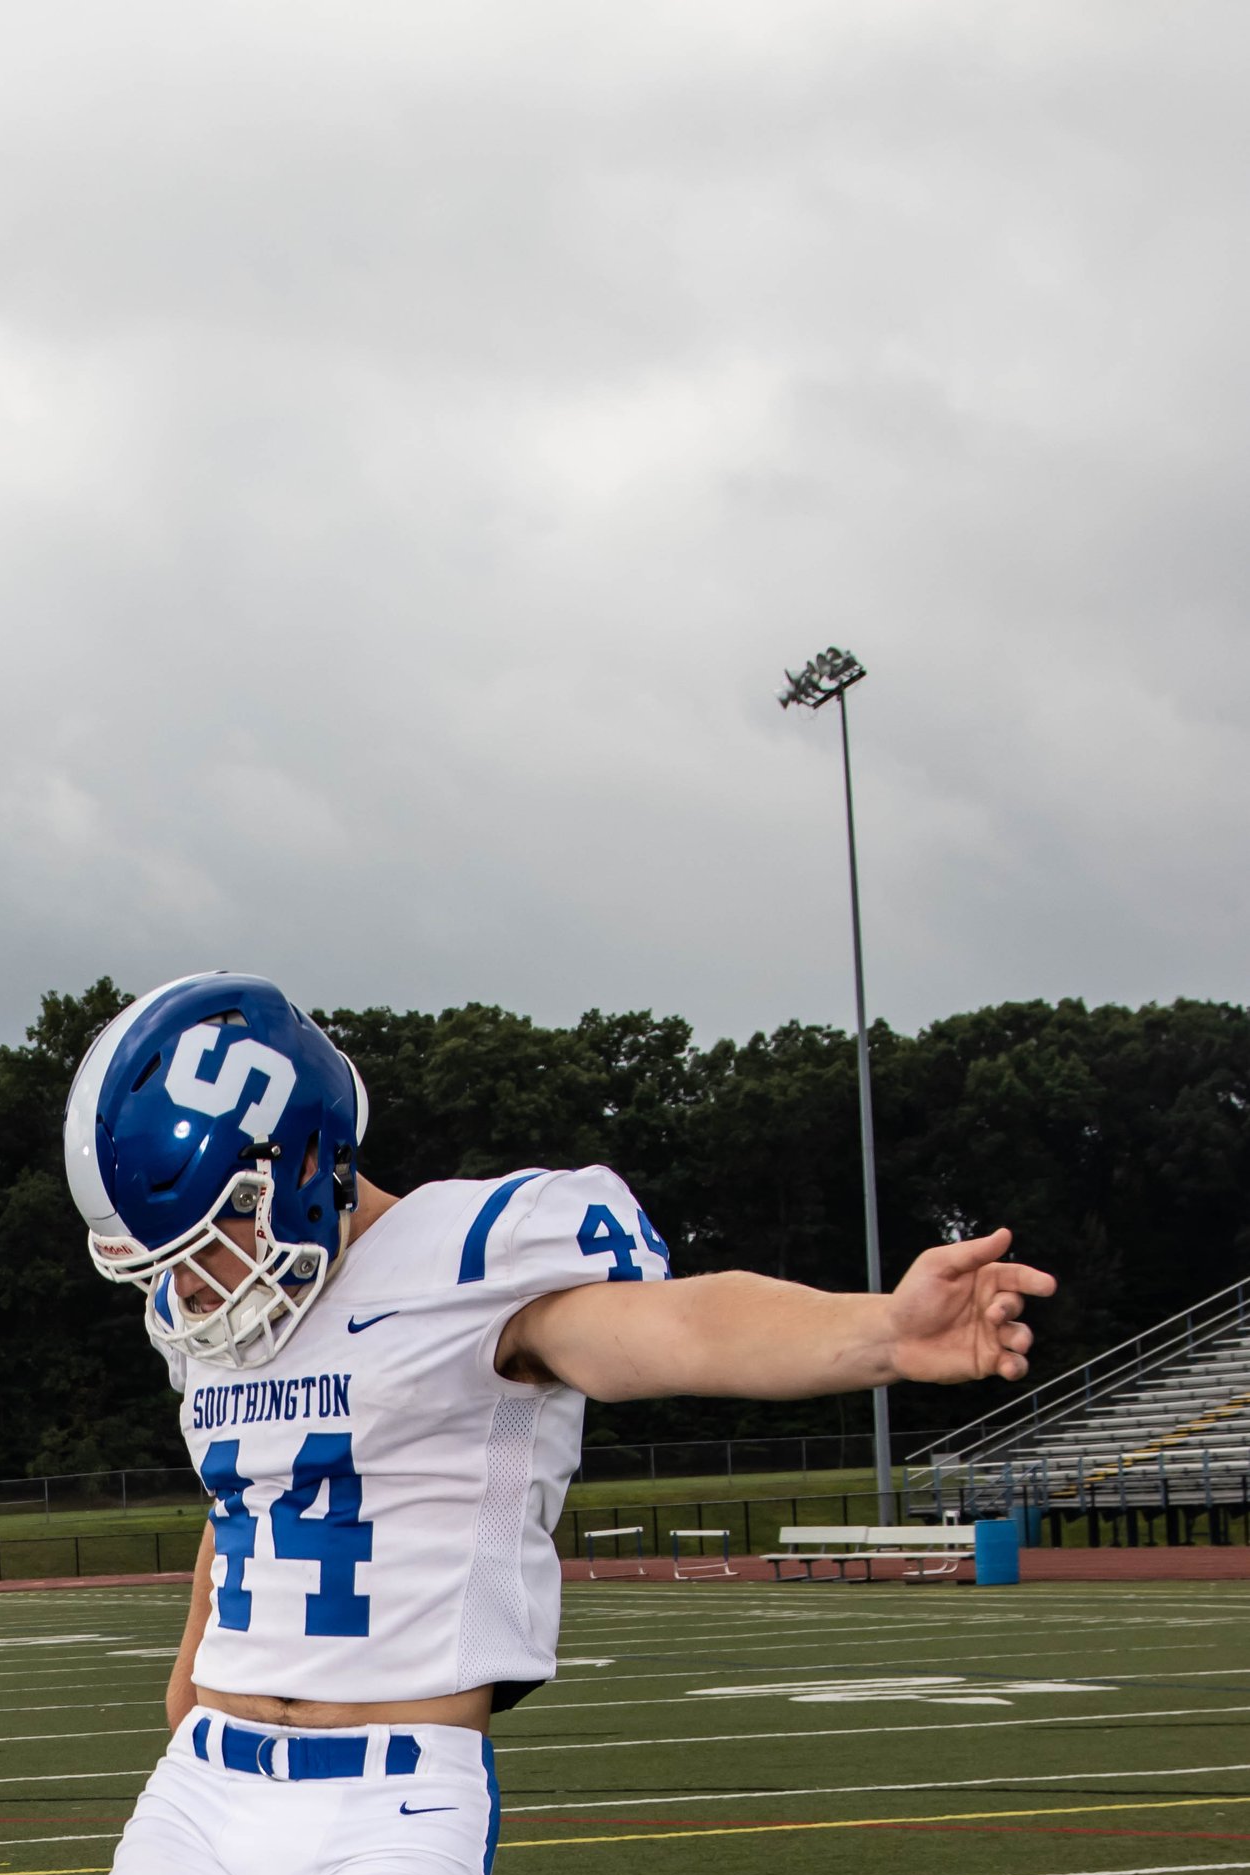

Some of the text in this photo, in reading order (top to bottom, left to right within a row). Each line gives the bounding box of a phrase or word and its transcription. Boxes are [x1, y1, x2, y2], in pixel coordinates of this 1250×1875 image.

[164, 1023, 297, 1138] S
[193, 1374, 352, 1430] SOUTHINGTON
[200, 1432, 374, 1637] 44
